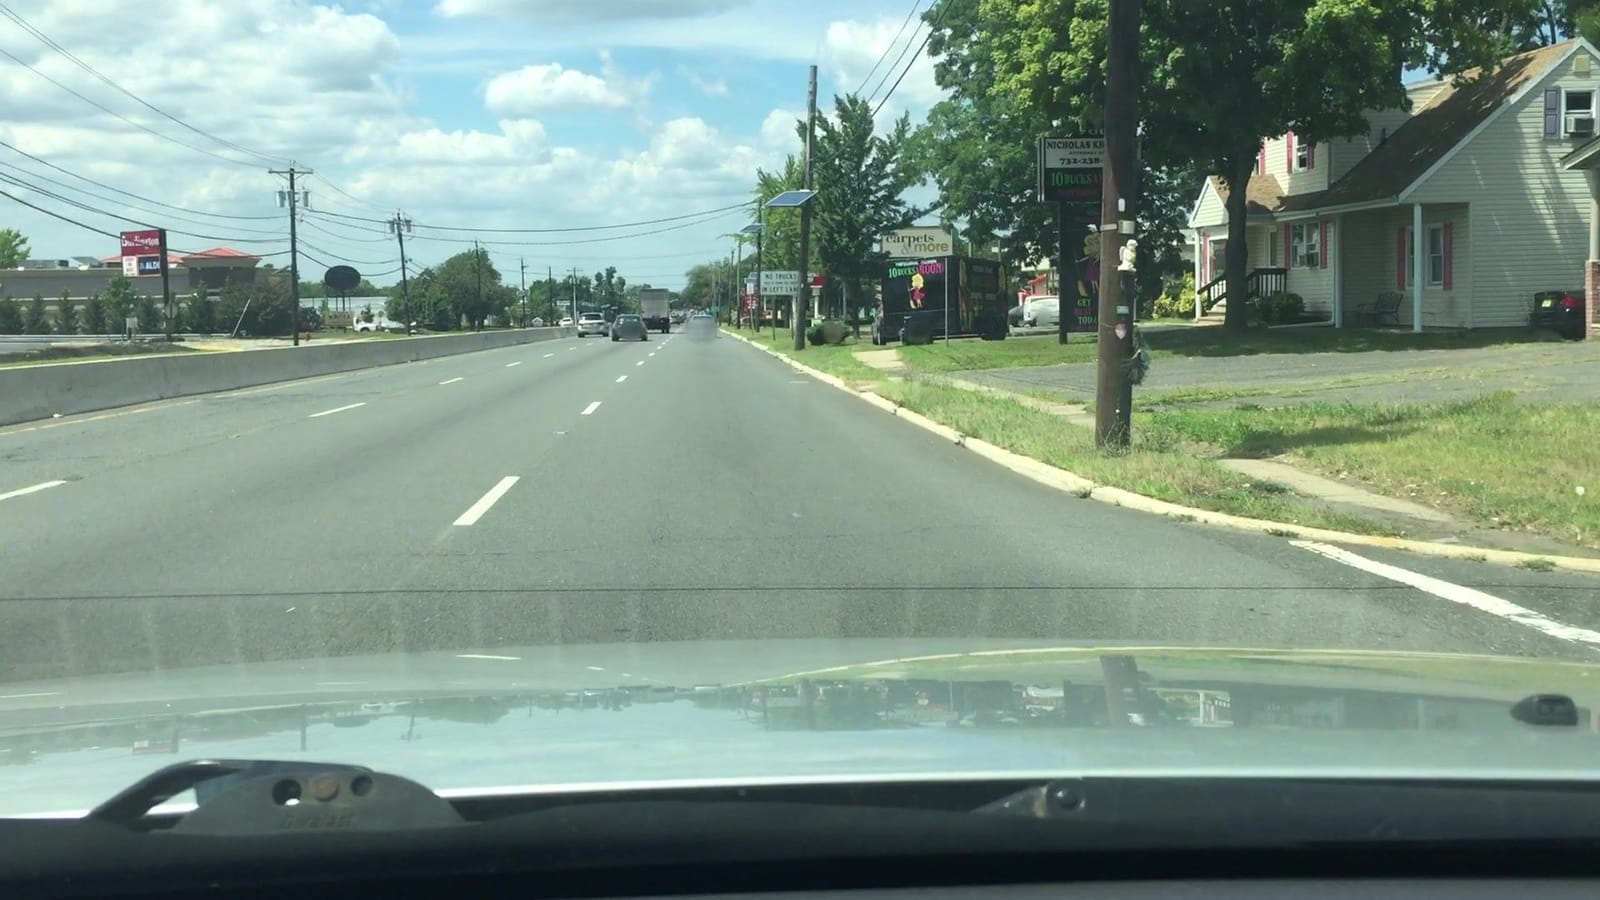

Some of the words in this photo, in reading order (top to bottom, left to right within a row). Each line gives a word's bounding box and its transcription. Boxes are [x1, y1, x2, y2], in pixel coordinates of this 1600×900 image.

[1046, 141, 1091, 150] NICHOLAS
[886, 234, 935, 248] carpets
[914, 243, 949, 253] more
[775, 273, 797, 281] TRUCKS
